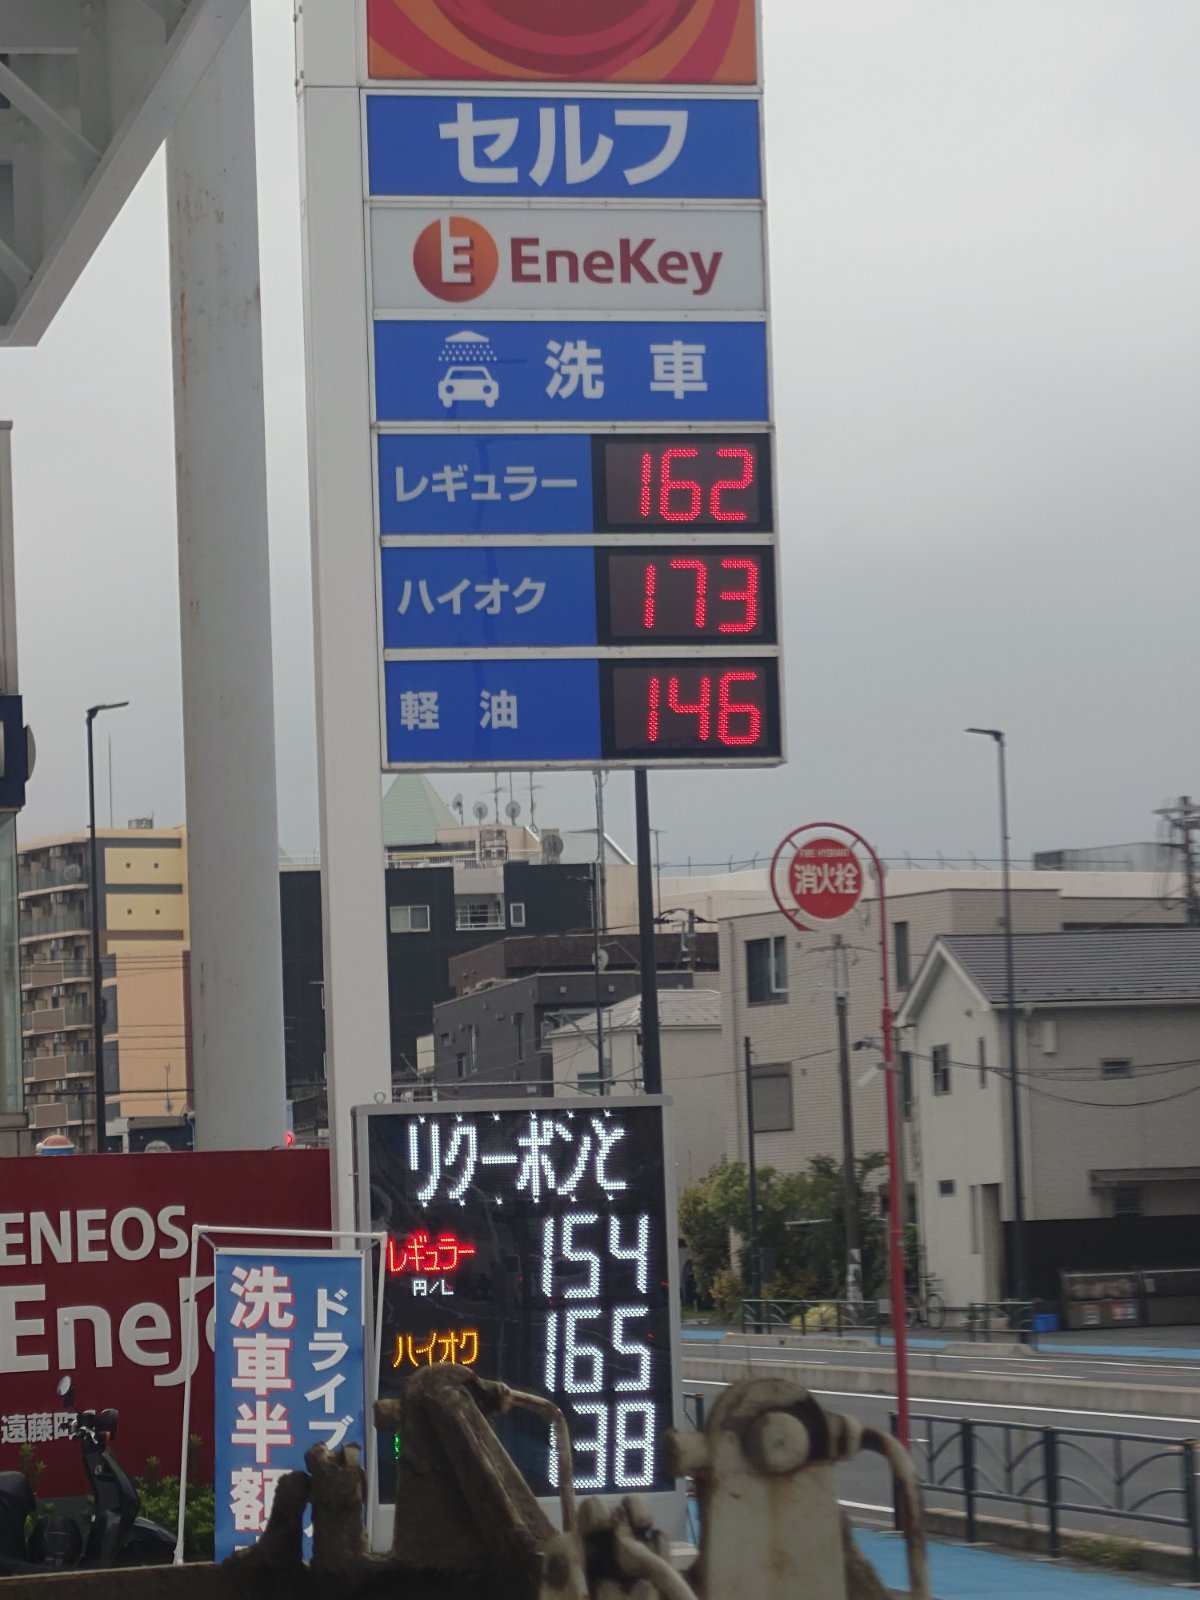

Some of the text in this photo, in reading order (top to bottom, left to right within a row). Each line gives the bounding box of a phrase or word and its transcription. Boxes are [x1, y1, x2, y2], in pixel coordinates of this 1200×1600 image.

[438, 102, 689, 187] セルフ
[510, 238, 723, 296] EneKey
[544, 340, 708, 400] 洗車
[395, 448, 754, 522] レギュラー 162
[397, 559, 759, 633] ハイオク 173
[400, 672, 762, 745] 軽油 146
[794, 862, 859, 895] 消火栓
[0, 1205, 189, 1267] ENEOS
[389, 1214, 650, 1299] レギュラー 154
[413, 1279, 455, 1296] 円/L
[0, 1276, 214, 1387] EneJ
[393, 1307, 652, 1394] ハイオク 165
[229, 1266, 296, 1553] 洗車半額
[548, 1402, 655, 1489] 138
